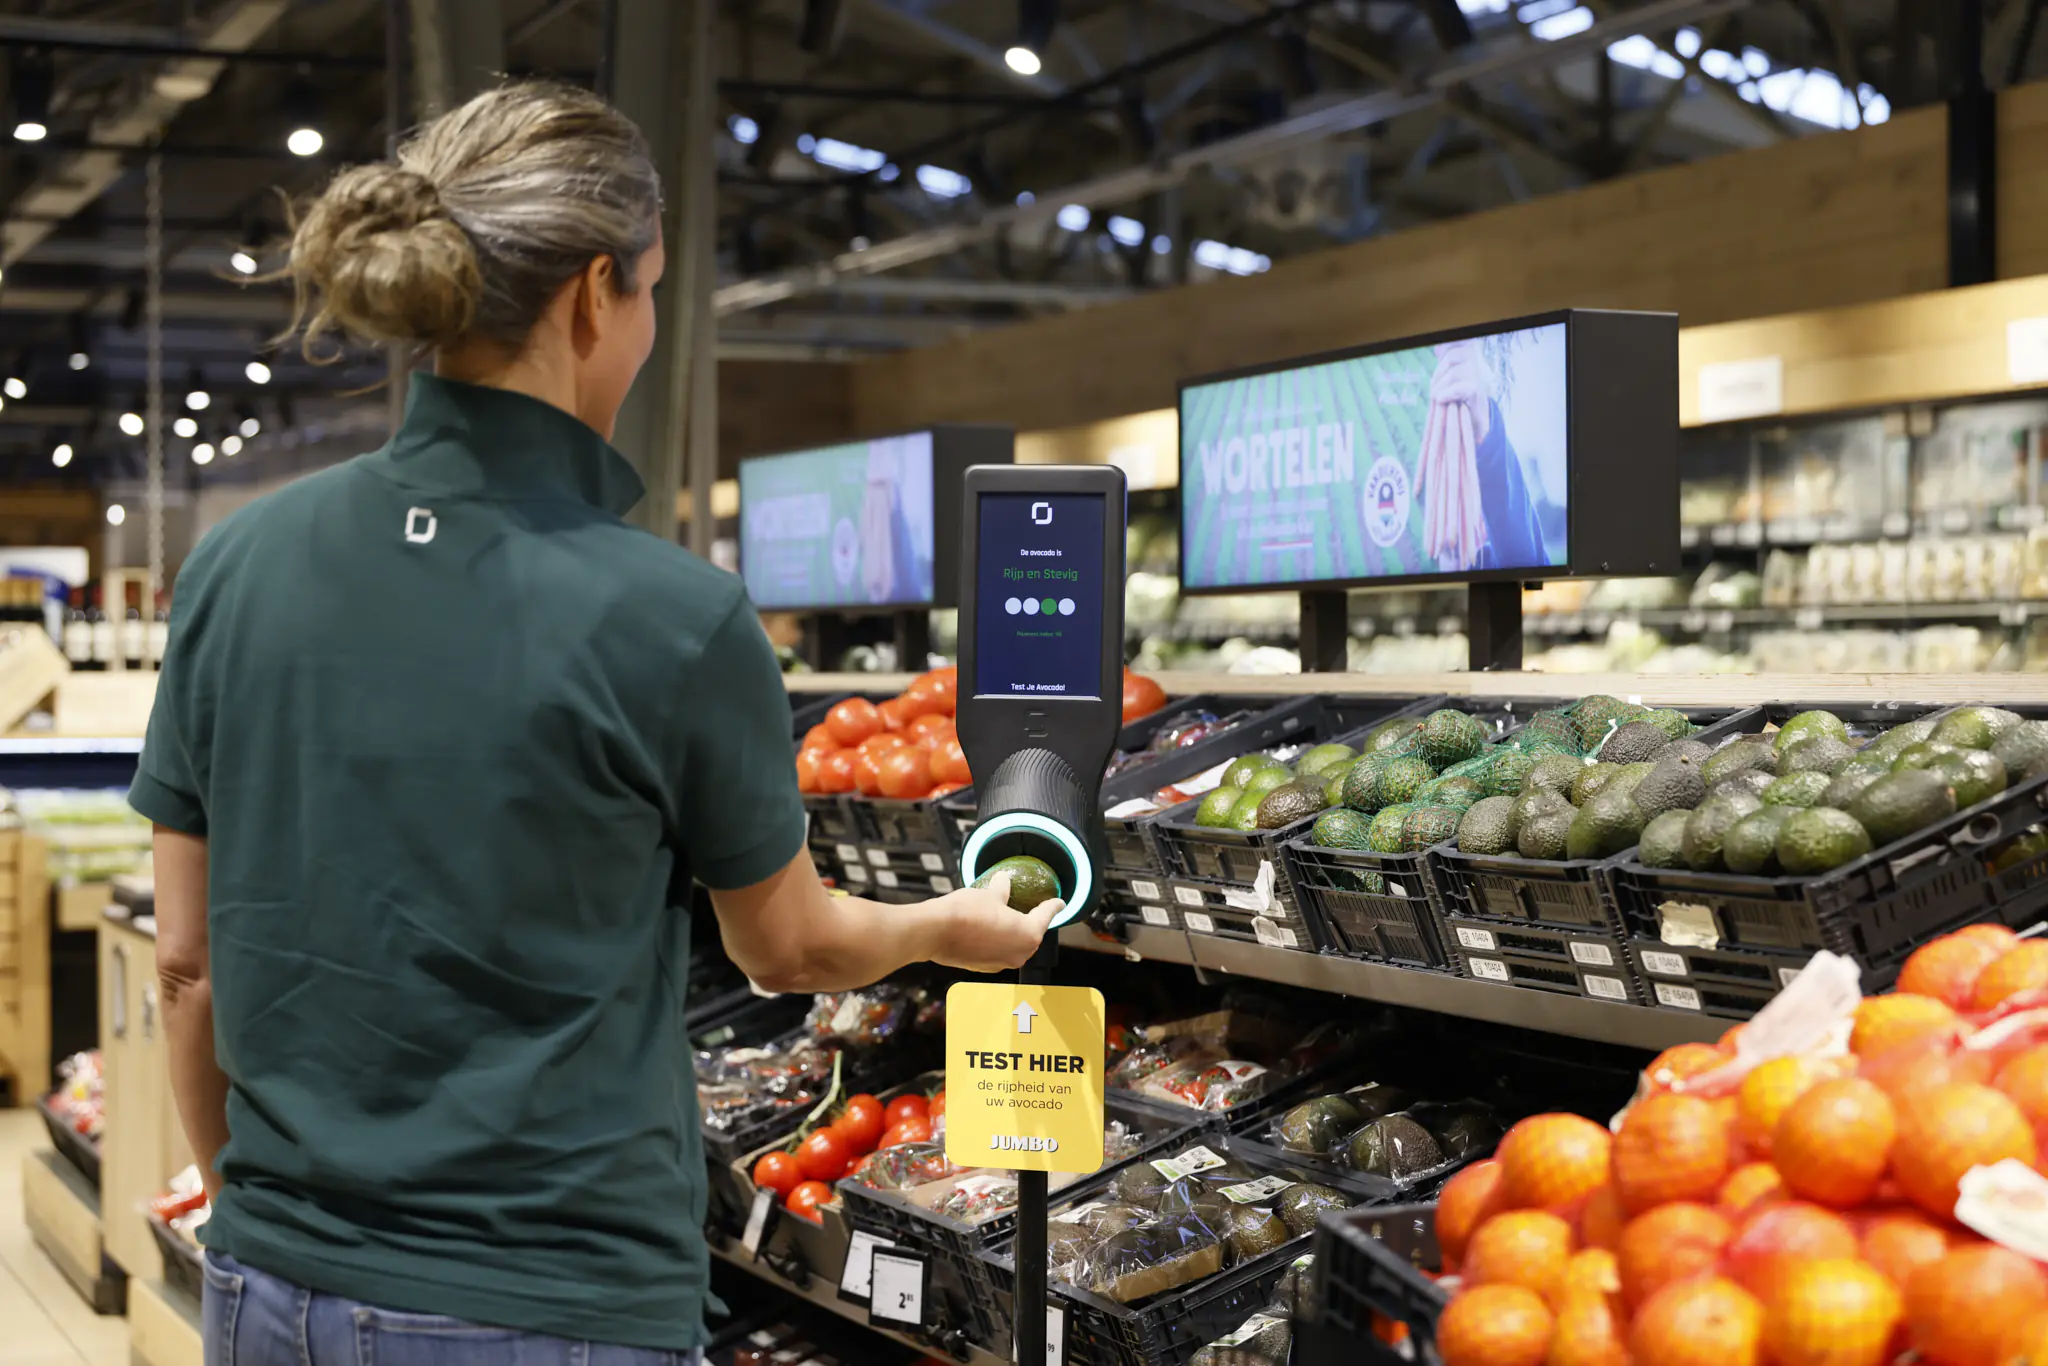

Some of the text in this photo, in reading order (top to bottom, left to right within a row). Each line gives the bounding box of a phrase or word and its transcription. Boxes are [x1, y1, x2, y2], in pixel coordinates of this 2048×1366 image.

[1200, 421, 1354, 495] WORTELEN
[1030, 549, 1055, 557] avocado
[1003, 567, 1078, 581] Rijp en Stevig
[1011, 683, 1066, 692] Test Je Avocado!
[965, 1050, 1085, 1074] TEST HIER
[977, 1079, 1072, 1095] de rijpheid van
[986, 1098, 1063, 1110] uw avocado
[989, 1134, 1059, 1152] JUMBO
